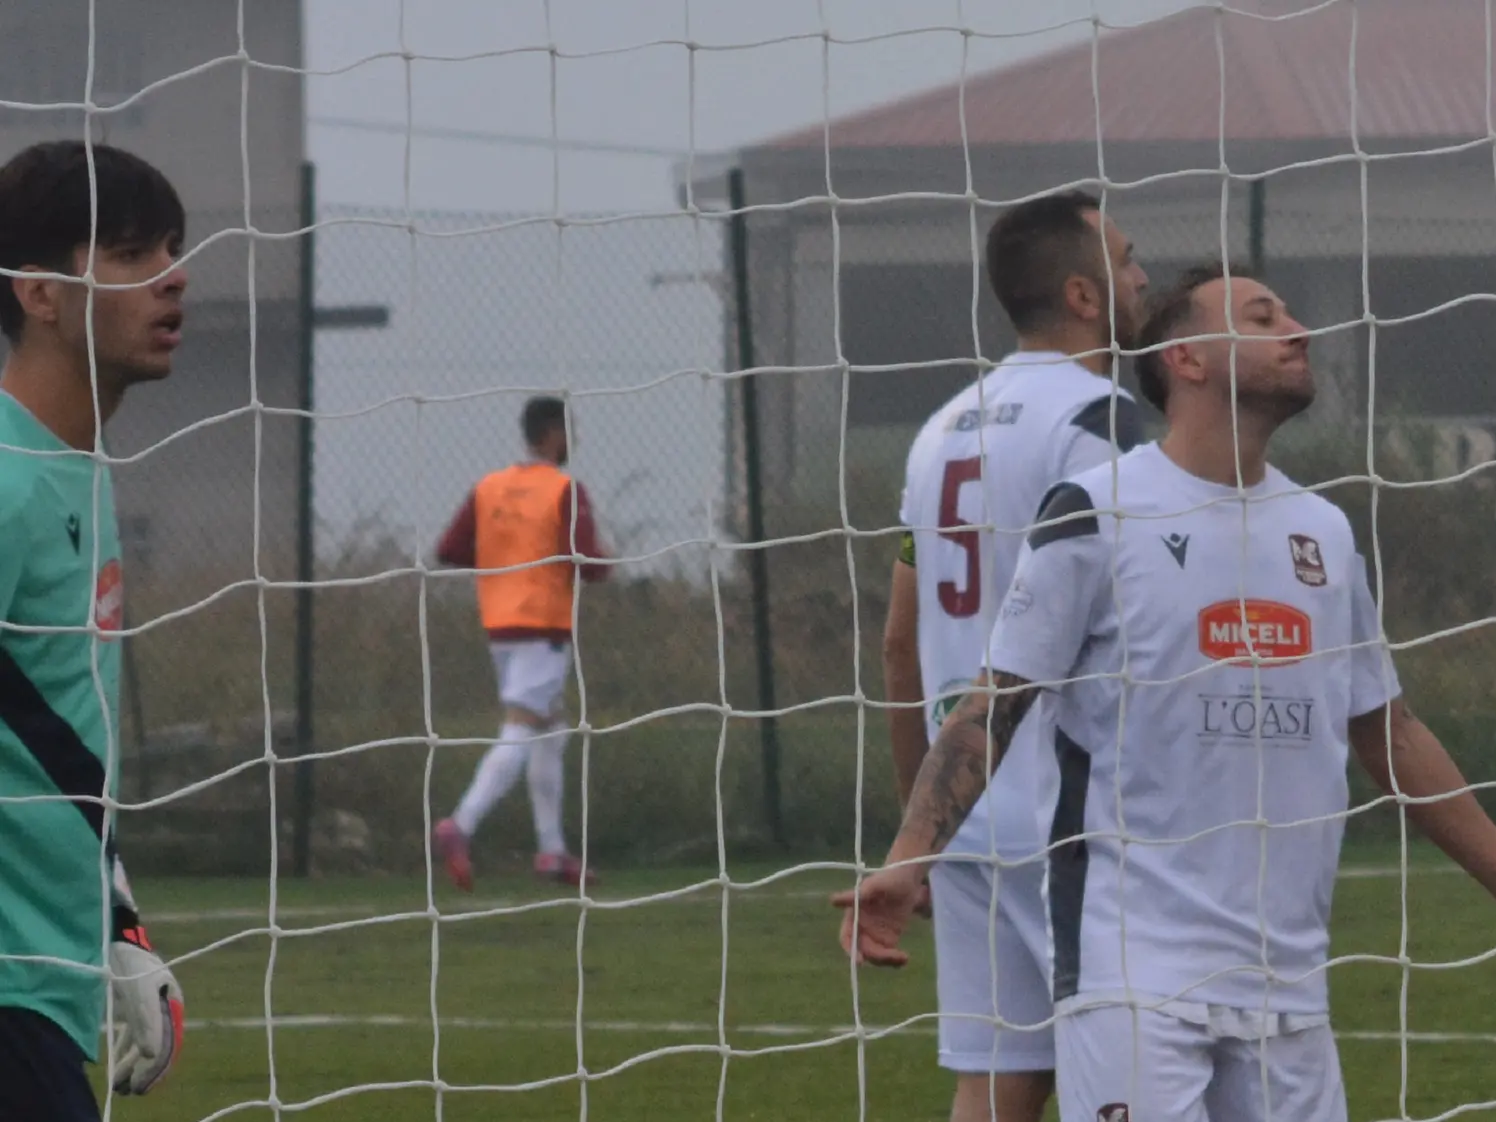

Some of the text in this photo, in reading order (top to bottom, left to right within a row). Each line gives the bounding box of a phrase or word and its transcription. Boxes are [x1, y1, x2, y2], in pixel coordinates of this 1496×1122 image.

[937, 453, 983, 619] 5
[1209, 620, 1301, 645] MICELI
[1202, 700, 1314, 735] L'OASI
